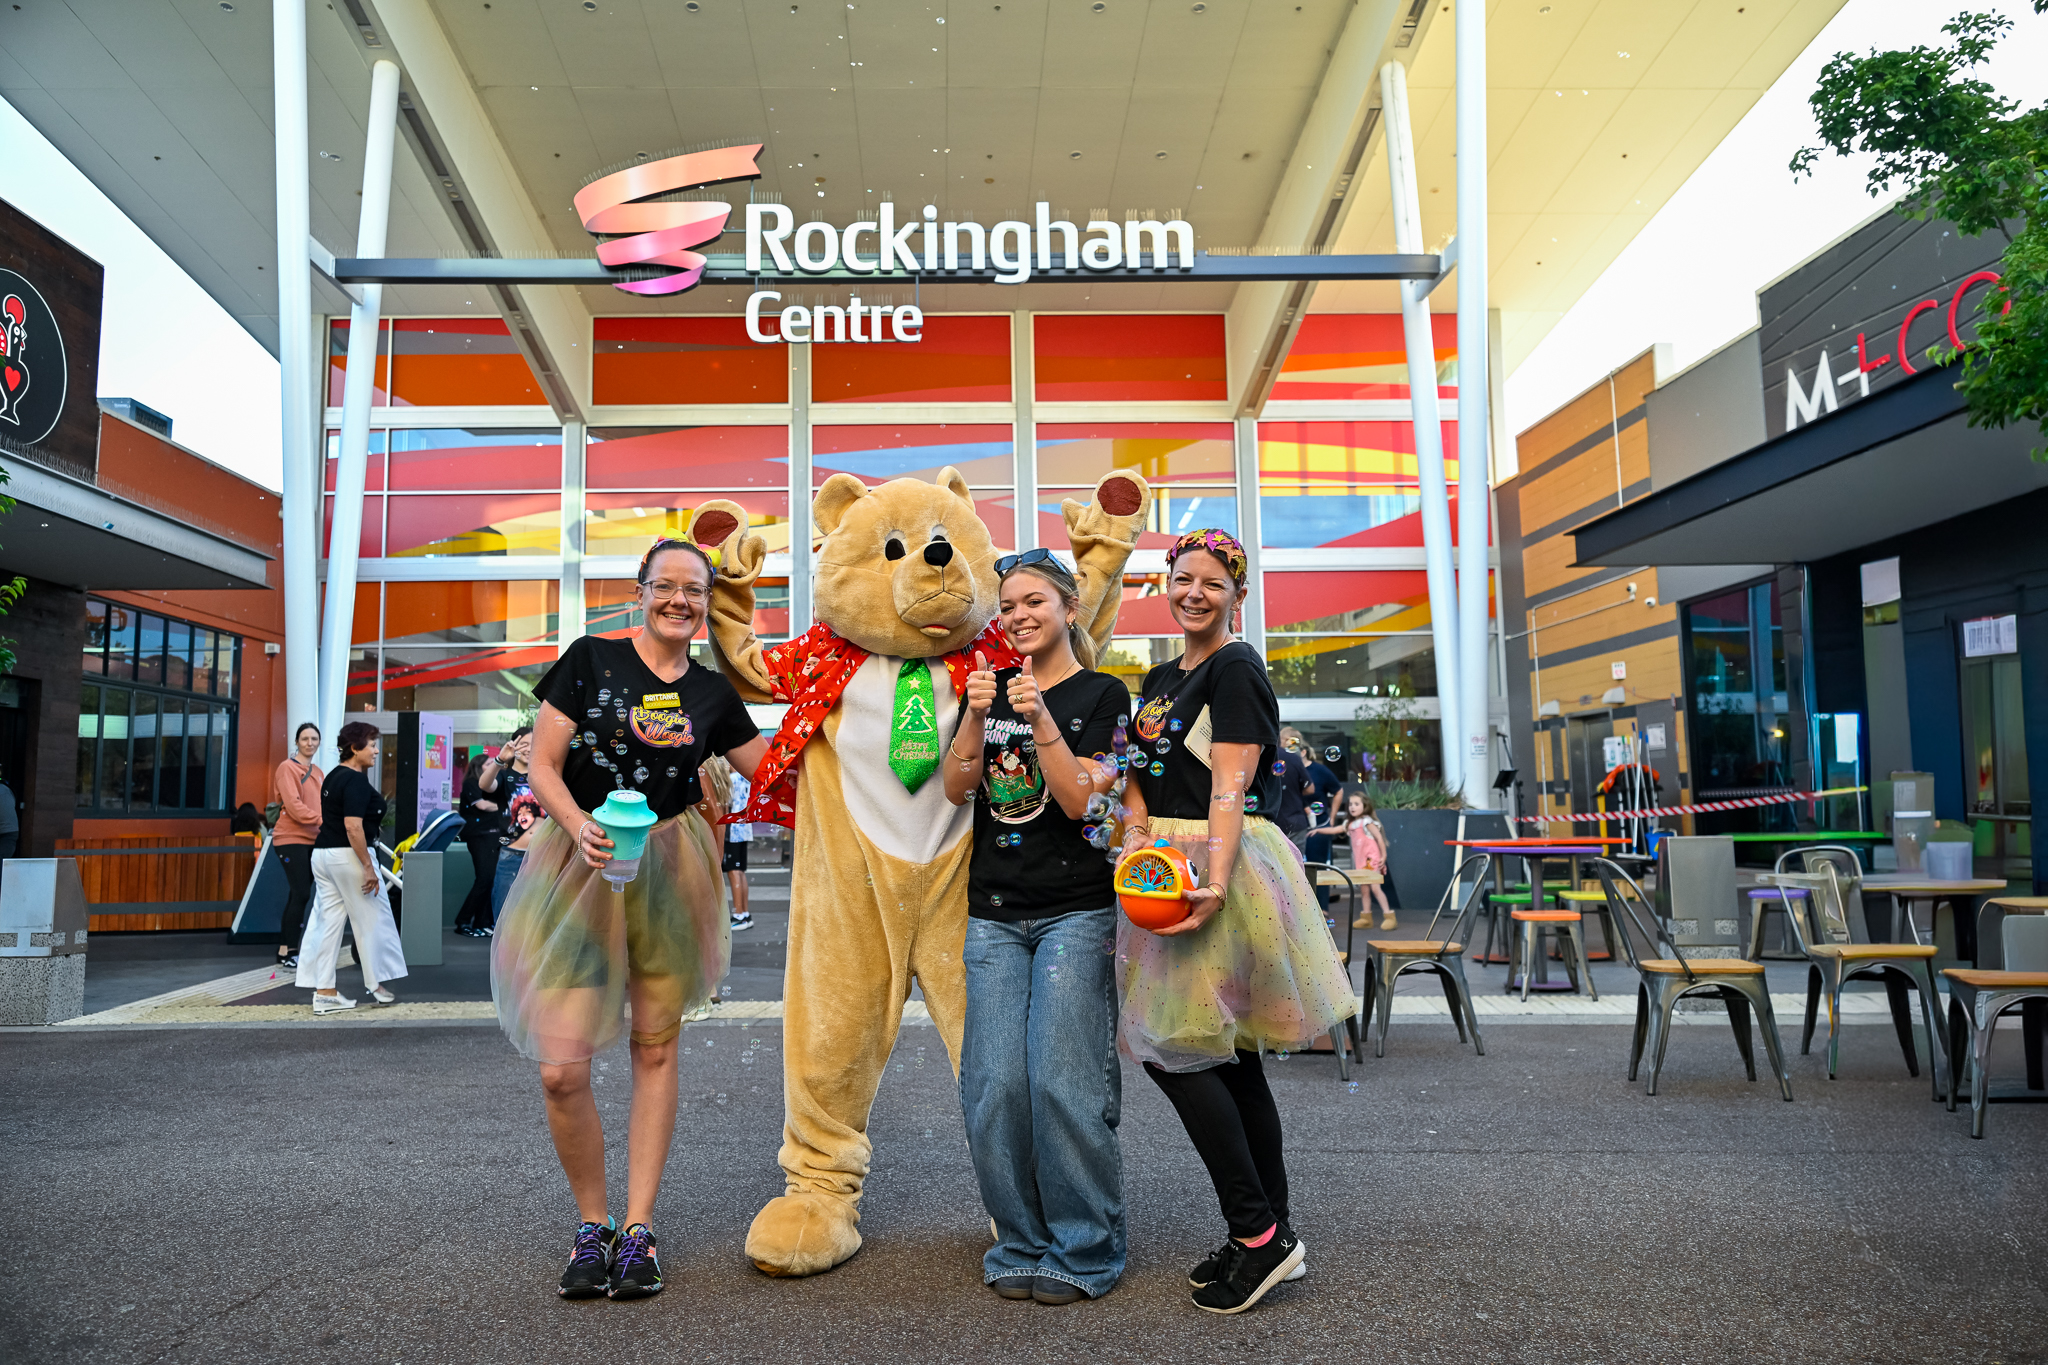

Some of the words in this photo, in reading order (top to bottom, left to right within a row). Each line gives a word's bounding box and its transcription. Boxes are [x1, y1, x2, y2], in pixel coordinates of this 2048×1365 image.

[745, 201, 1196, 285] Rockingham
[745, 290, 925, 344] Centre
[635, 706, 689, 728] Boogie
[643, 720, 694, 747] Woogie
